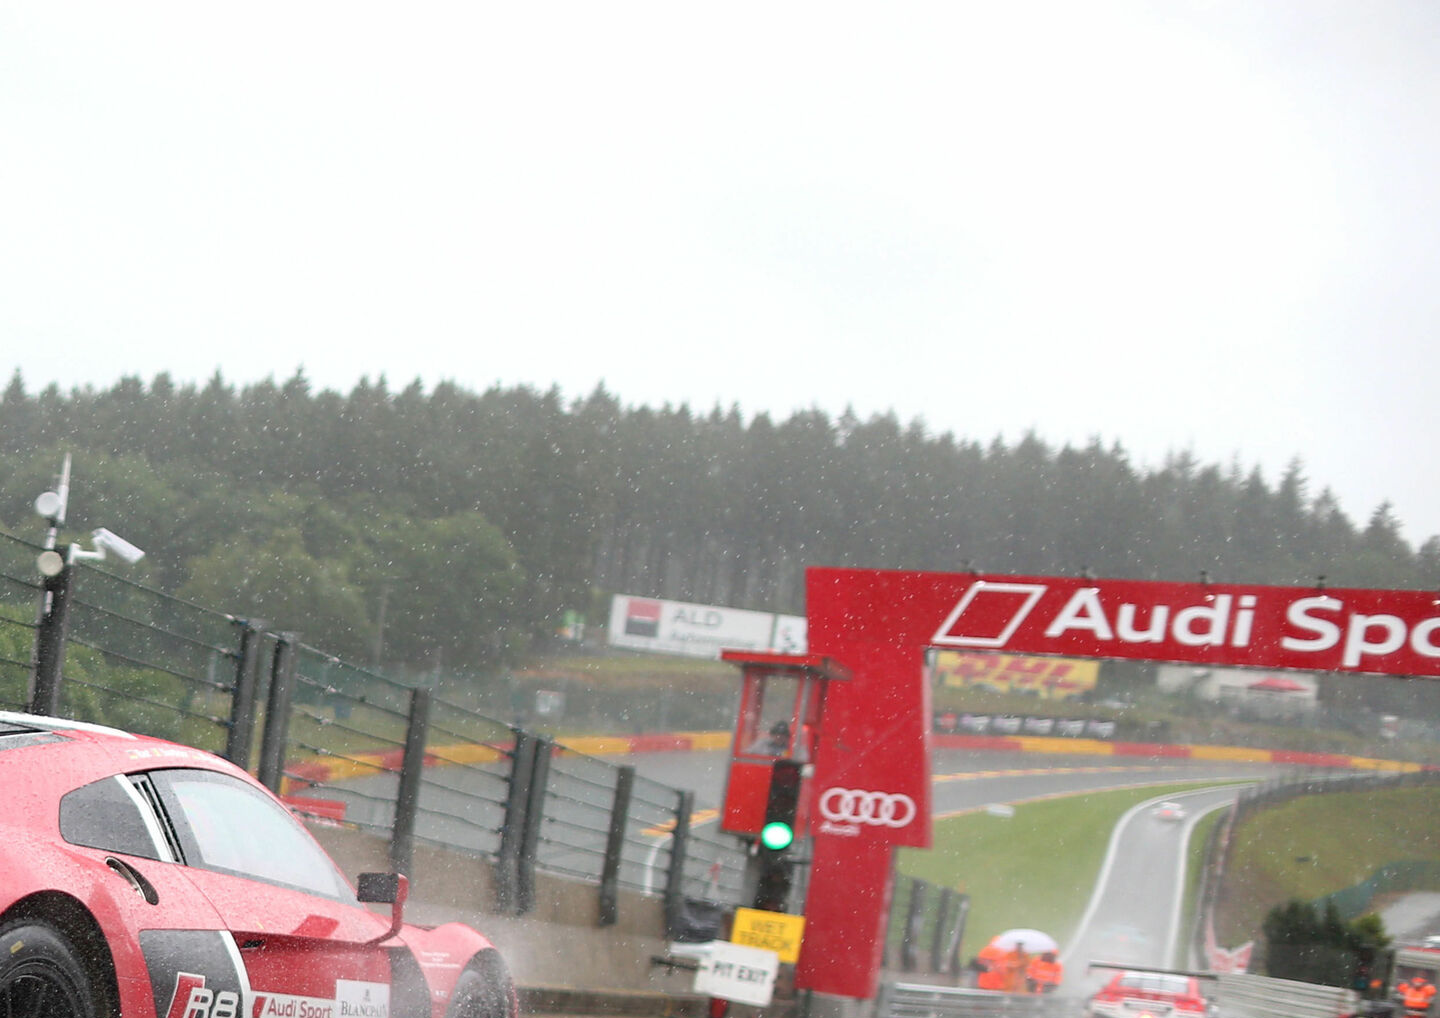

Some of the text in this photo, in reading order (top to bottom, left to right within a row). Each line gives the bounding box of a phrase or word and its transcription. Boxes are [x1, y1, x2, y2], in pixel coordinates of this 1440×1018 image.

[672, 608, 724, 628] ALD
[1044, 586, 1257, 648] Audi
[953, 653, 1079, 689] DHL
[712, 961, 769, 984] PIT EXIT
[268, 998, 297, 1018] Audi
